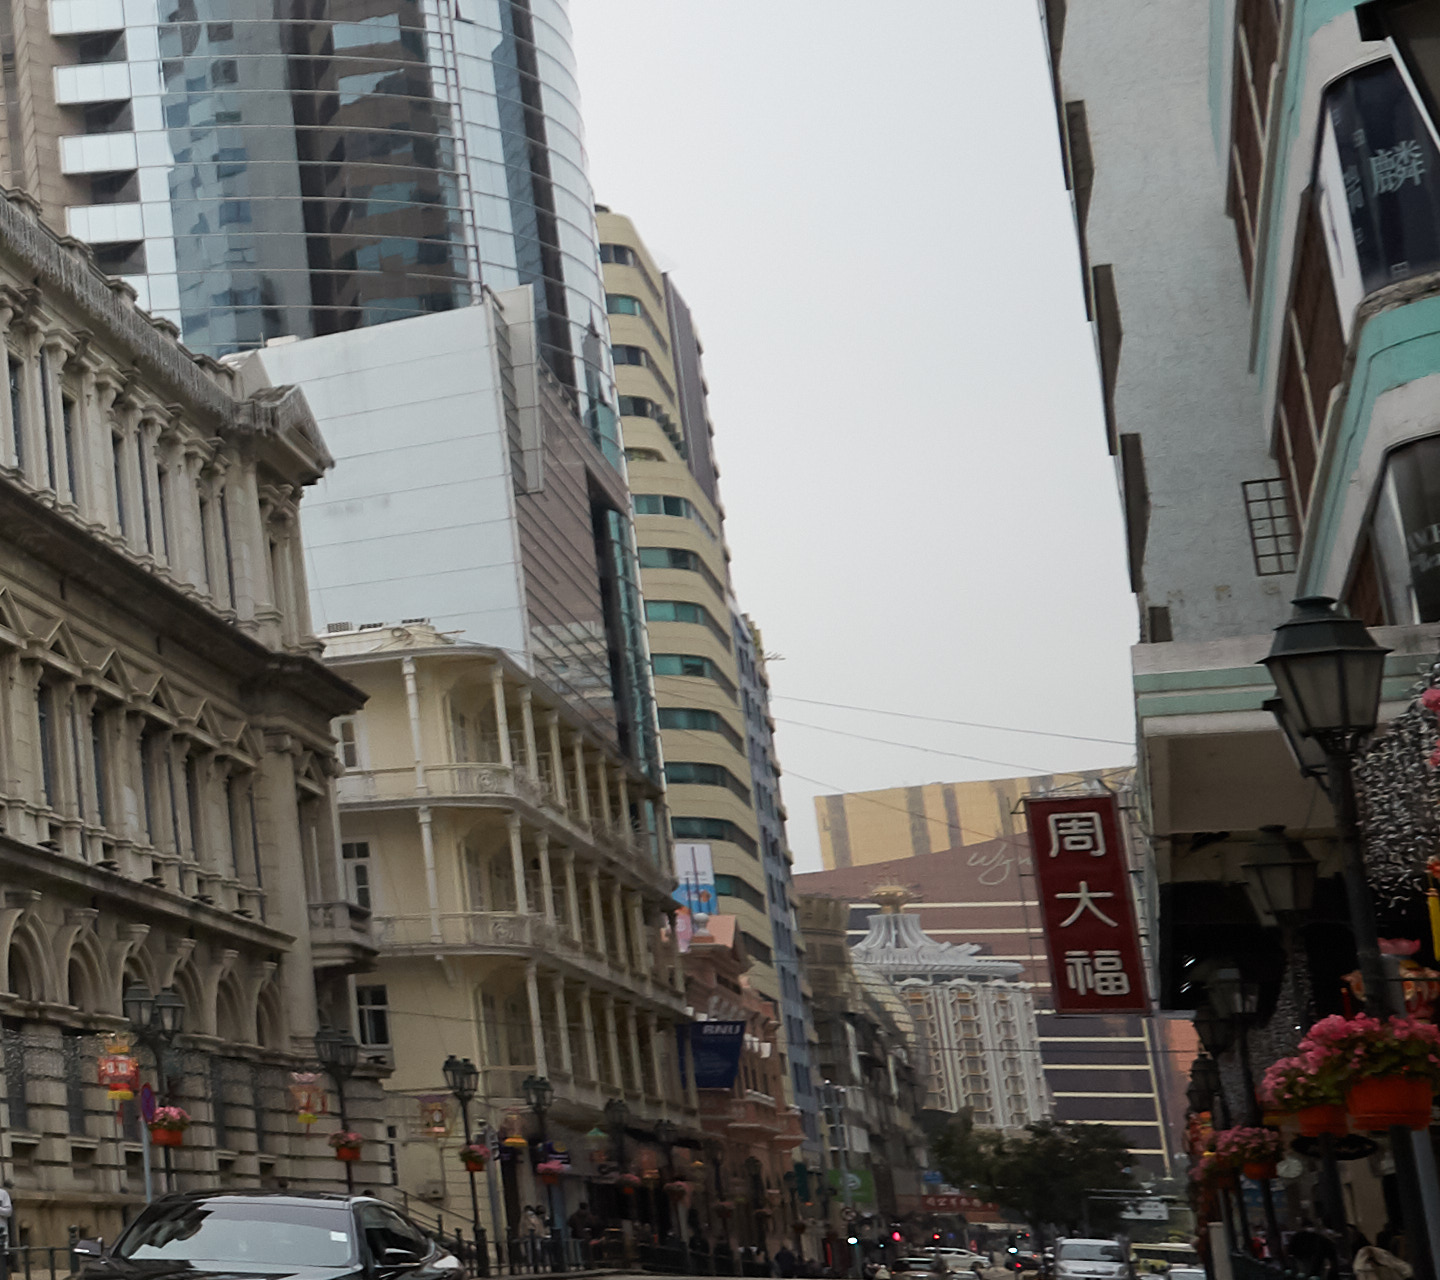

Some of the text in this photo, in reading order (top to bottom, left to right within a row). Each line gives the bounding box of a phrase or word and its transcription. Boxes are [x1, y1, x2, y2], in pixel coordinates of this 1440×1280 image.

[967, 842, 1033, 885] Wyn
[1048, 811, 1130, 996] 周大福
[703, 1023, 740, 1035] BNU
